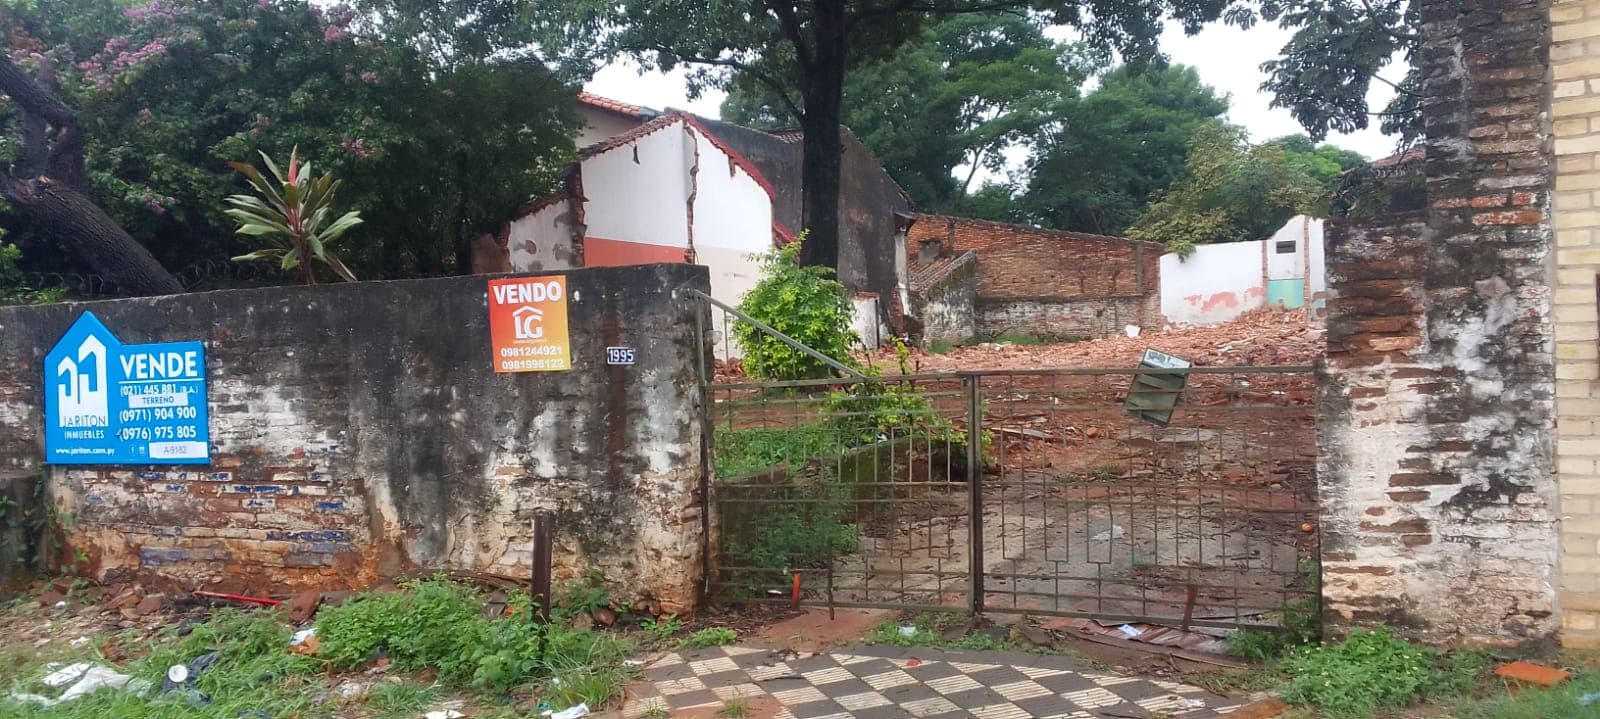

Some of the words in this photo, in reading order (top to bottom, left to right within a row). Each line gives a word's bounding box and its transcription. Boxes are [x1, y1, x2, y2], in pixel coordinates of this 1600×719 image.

[493, 281, 562, 305] VENDO
[514, 314, 543, 339] LG
[501, 345, 562, 357] 0981244921
[610, 349, 634, 362] 1995
[119, 351, 198, 379] VENDE
[120, 385, 142, 397] (021)
[143, 384, 159, 394] 445
[142, 396, 174, 404] TERRENO
[63, 415, 106, 428] JARITON
[119, 409, 151, 424] (0971)
[154, 408, 174, 420] 904
[177, 406, 196, 419] 900
[64, 430, 105, 439] INMUEBLES
[119, 427, 151, 442] (0976)
[154, 426, 174, 439] 975
[177, 425, 196, 439] 805
